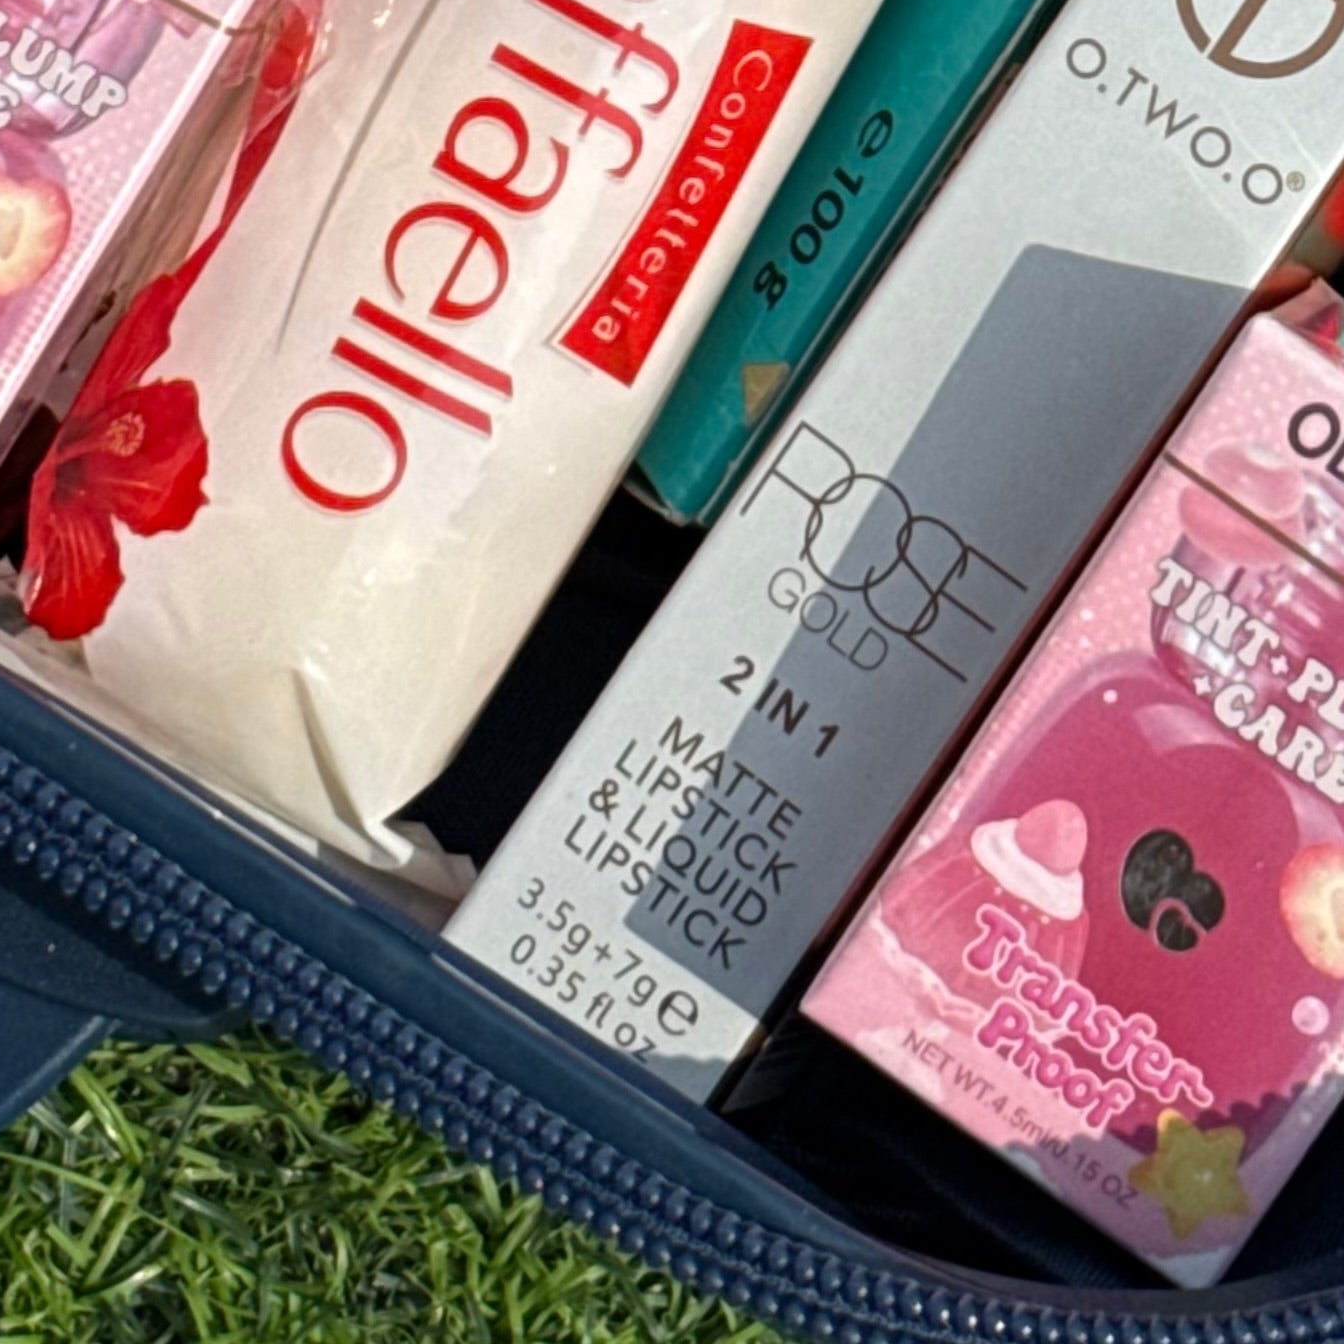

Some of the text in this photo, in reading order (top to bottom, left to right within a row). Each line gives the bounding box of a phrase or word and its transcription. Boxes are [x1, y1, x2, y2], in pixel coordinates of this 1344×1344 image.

[593, 48, 775, 342] Confetteria
[790, 165, 864, 267] 100
[753, 264, 788, 311] g
[767, 566, 888, 673] GOLD
[719, 655, 843, 759] 2 IN 1
[614, 734, 800, 897] LIPSTICK
[658, 714, 804, 838] MATTE
[563, 812, 746, 975] LIPSTICK
[587, 779, 770, 932] & LIQUID
[508, 934, 660, 1064] 0.35 fl oz
[899, 1028, 956, 1077] NET
[1097, 1171, 1141, 1212] OZ
[975, 1000, 1136, 1137] Proof
